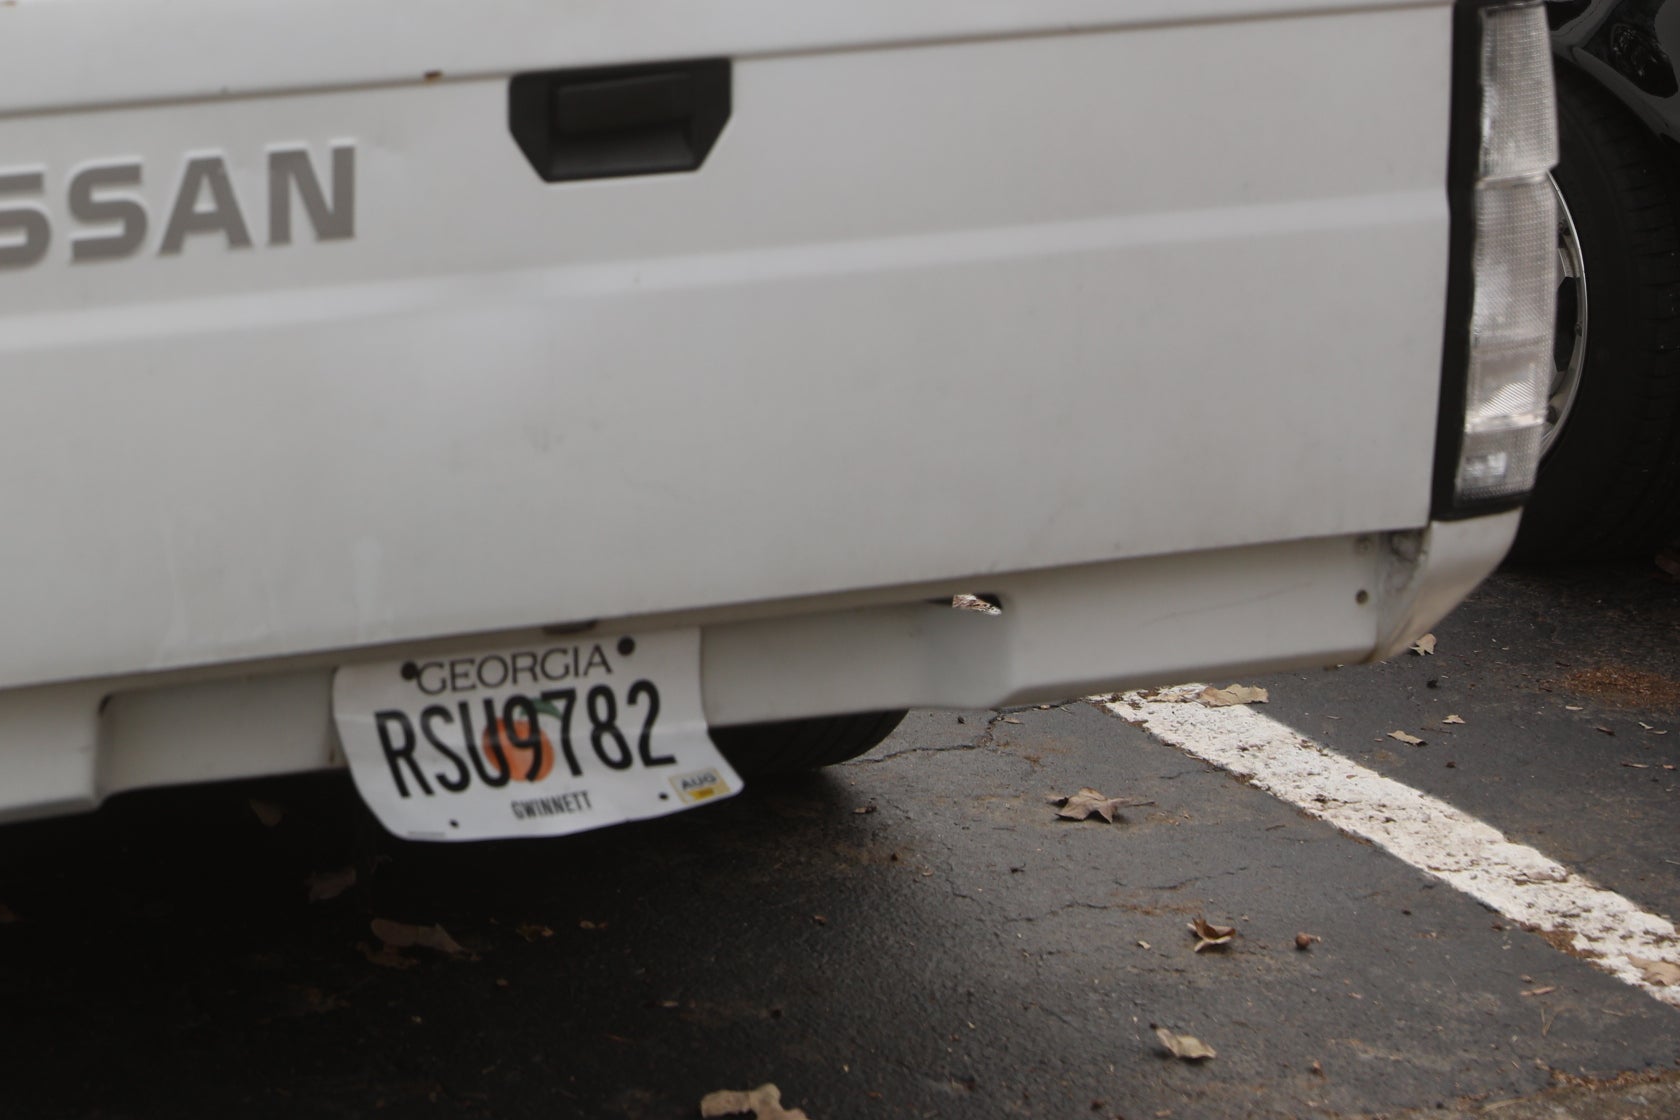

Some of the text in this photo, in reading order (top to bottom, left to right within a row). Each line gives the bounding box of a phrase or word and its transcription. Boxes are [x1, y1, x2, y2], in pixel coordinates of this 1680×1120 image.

[417, 643, 613, 696] GEORGIA
[373, 679, 678, 799] RSU9782
[510, 790, 593, 821] GWINNETT
